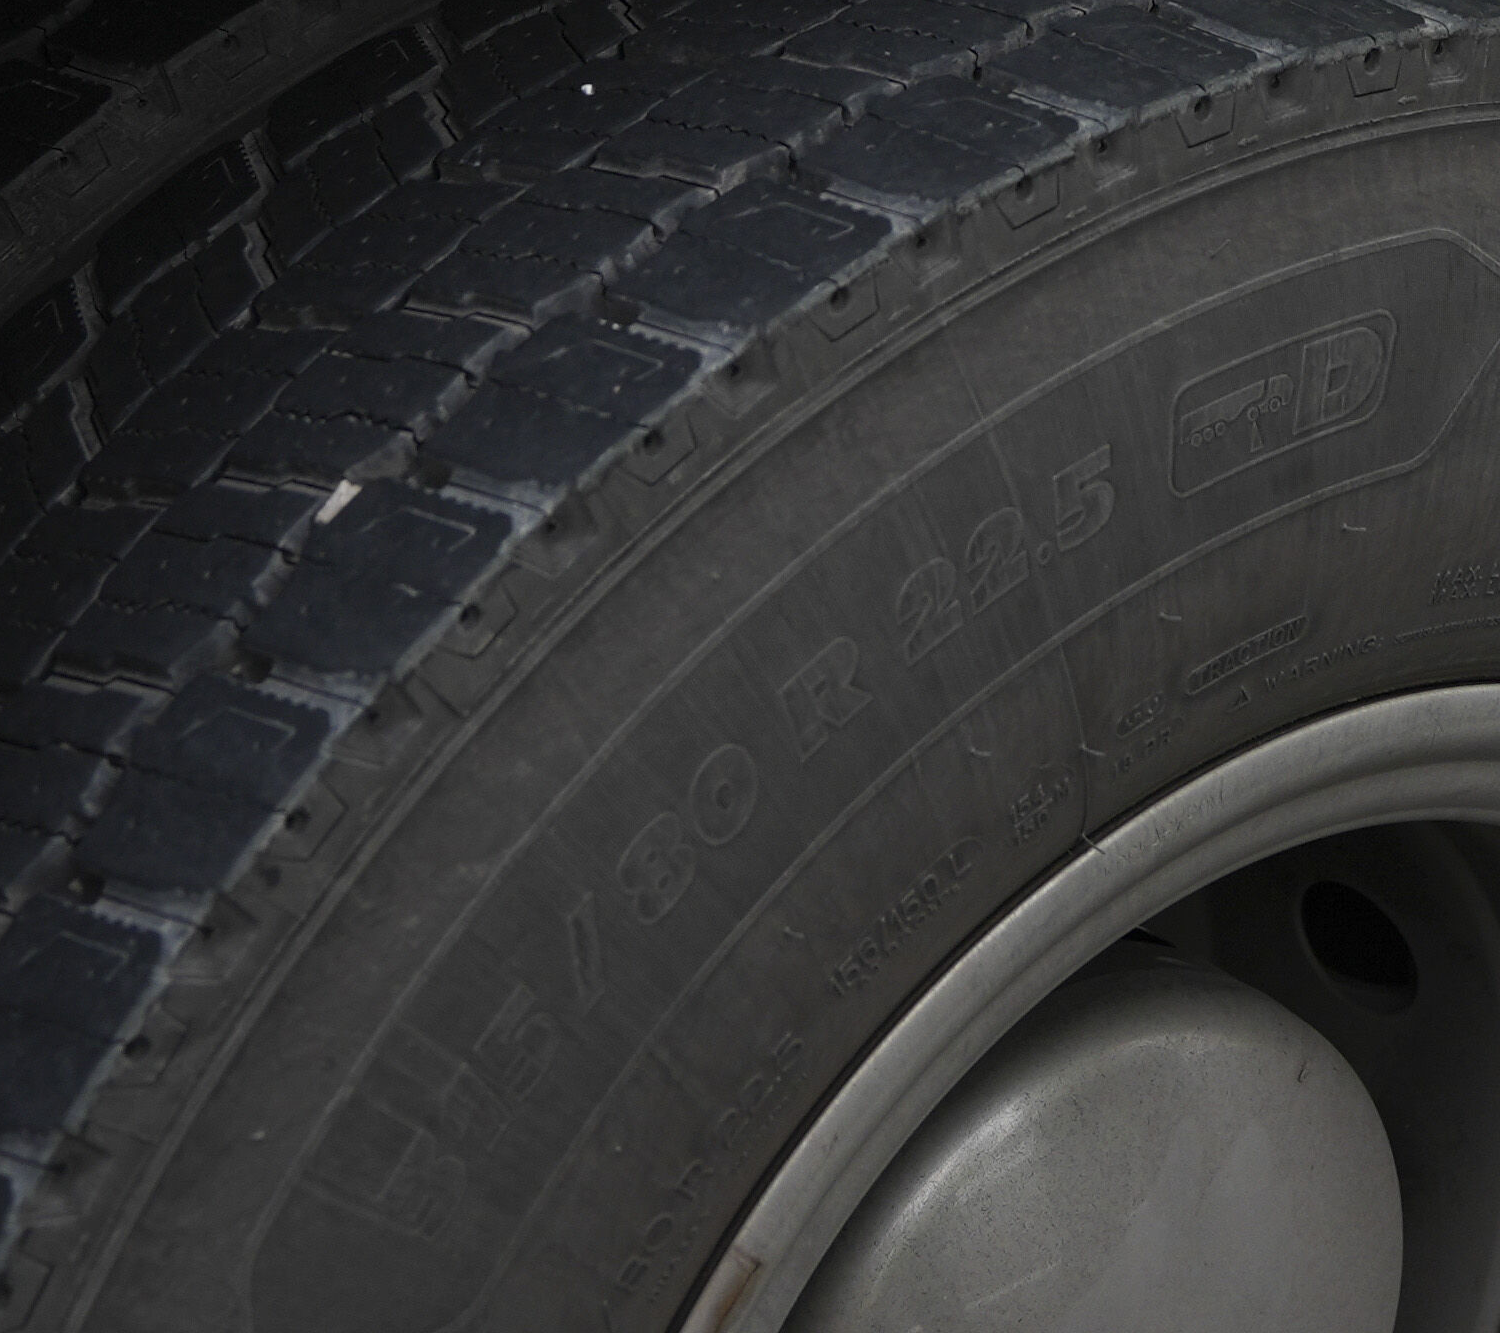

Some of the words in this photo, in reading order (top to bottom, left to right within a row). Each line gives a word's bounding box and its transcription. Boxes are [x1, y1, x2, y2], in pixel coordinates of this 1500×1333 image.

[780, 635, 874, 761] R
[895, 443, 1116, 667] 22.5
[1193, 621, 1304, 690] TRACTION
